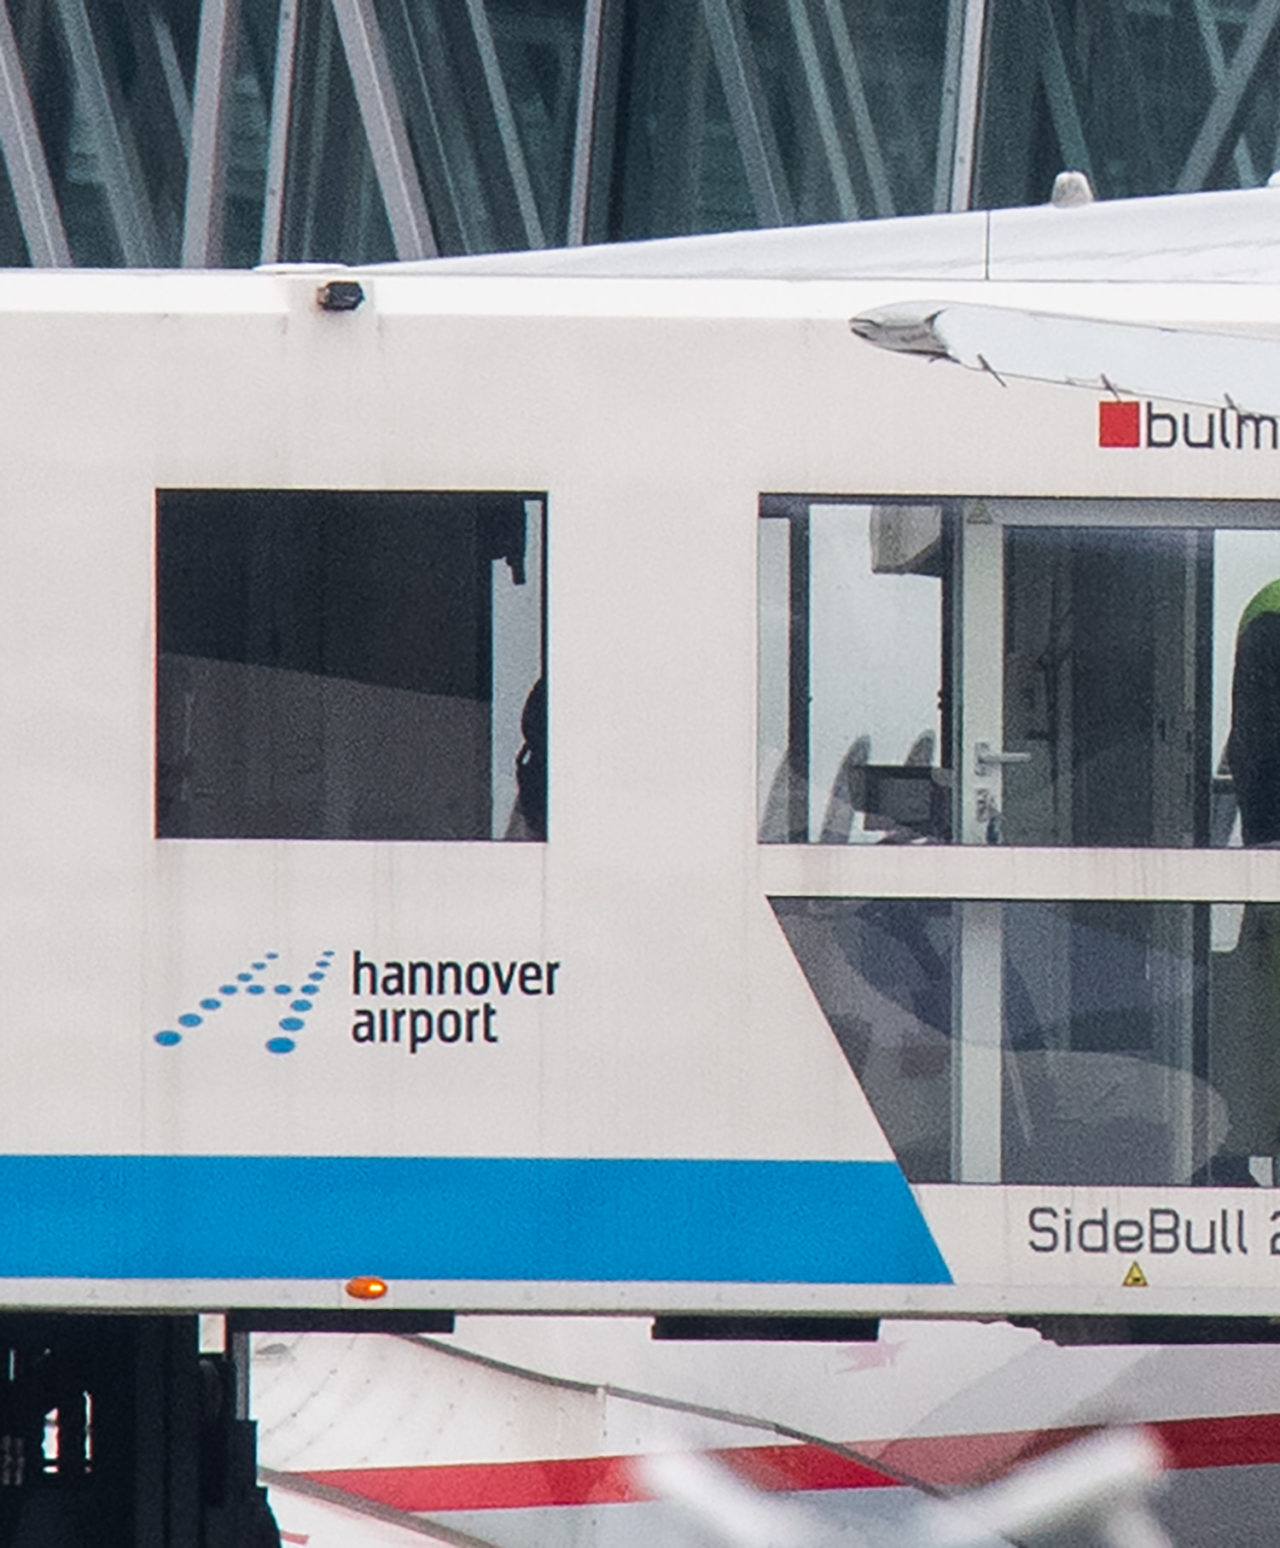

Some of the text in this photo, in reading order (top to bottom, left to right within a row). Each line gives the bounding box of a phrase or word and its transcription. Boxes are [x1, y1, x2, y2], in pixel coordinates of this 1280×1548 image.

[353, 950, 561, 996] hannover
[352, 1002, 498, 1054] airport
[1029, 1207, 1248, 1254] SideBull
